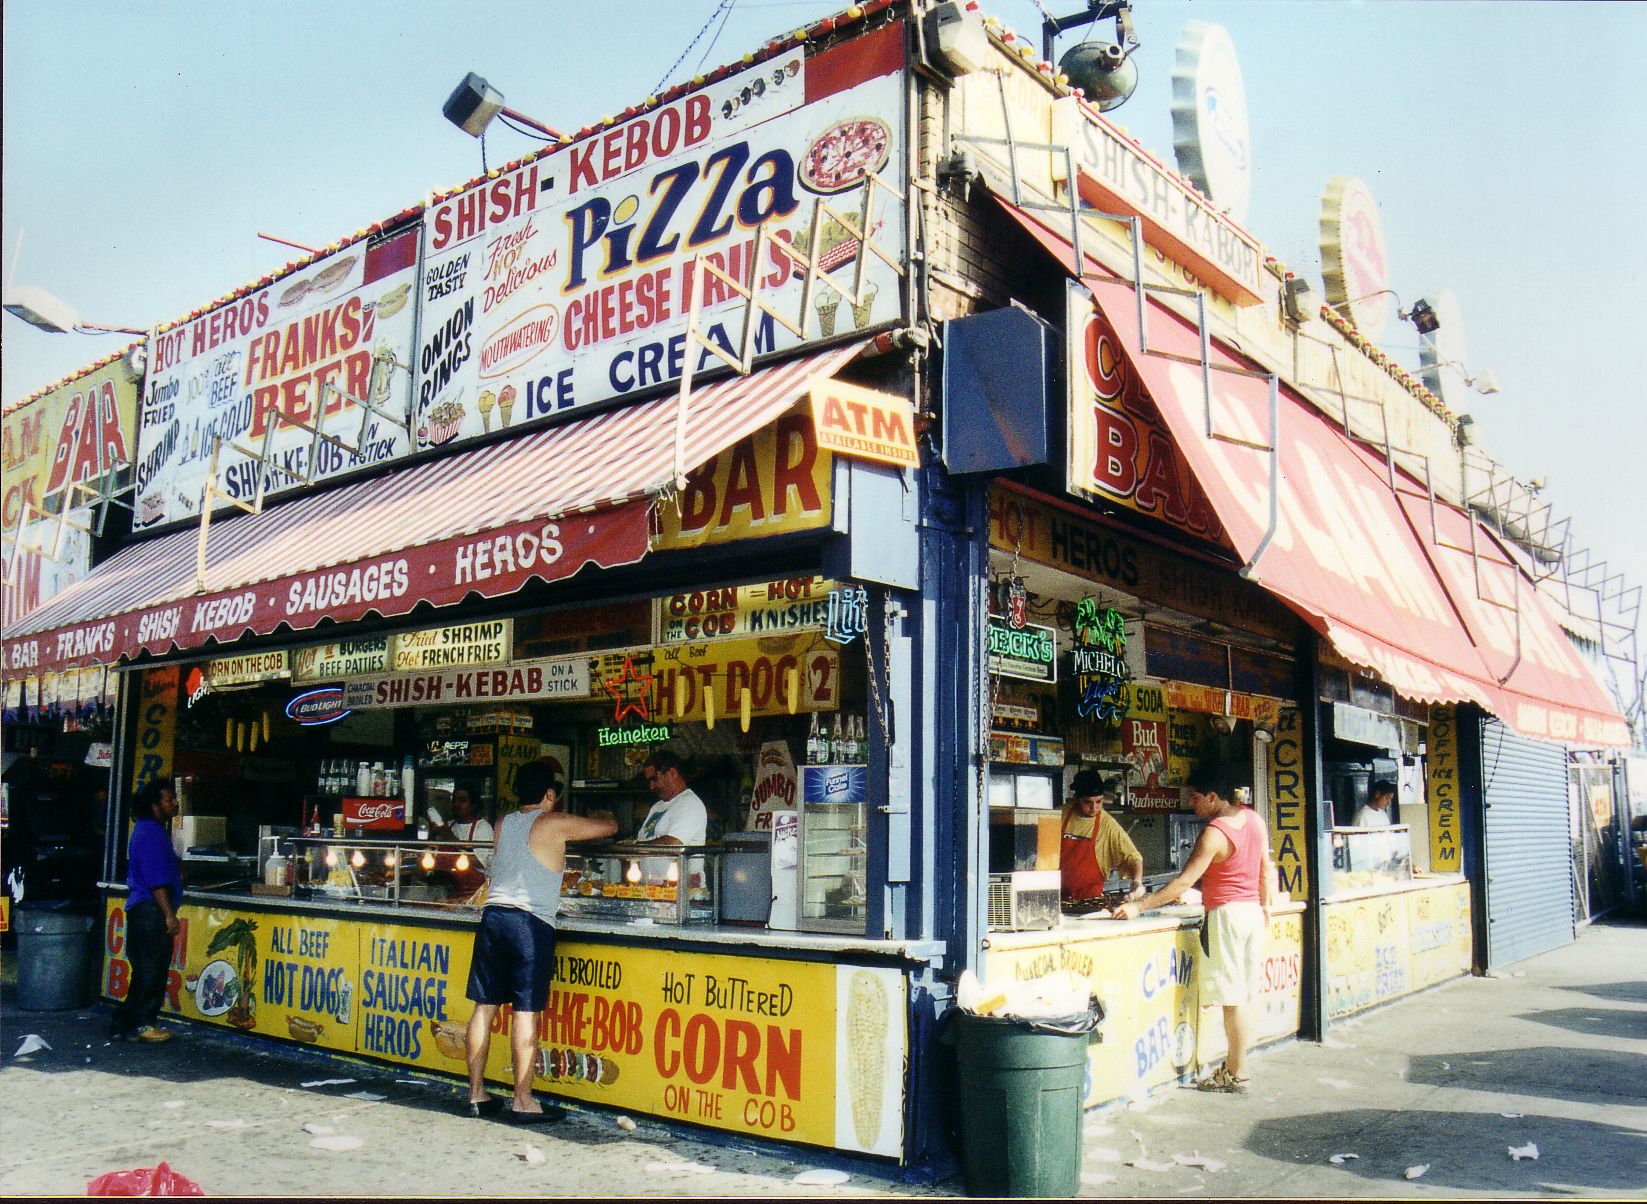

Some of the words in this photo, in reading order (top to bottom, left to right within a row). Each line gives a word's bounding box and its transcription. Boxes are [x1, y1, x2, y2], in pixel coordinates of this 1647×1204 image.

[484, 216, 539, 280] Fresh
[426, 252, 471, 285] GOLDEN
[428, 272, 466, 301] TASTY
[483, 249, 557, 313] Delicious
[563, 264, 671, 352] CHEESE
[153, 332, 185, 375] HOT
[191, 290, 269, 357] HEROS
[244, 296, 363, 386] FRANKS
[421, 296, 474, 374] ONION
[480, 315, 554, 372] MOUTHWATERING
[145, 376, 180, 407] Jumbo
[210, 372, 238, 405] BEEF
[418, 332, 472, 416] RINGS
[249, 350, 372, 438] BEER
[527, 368, 575, 418] ICE
[143, 402, 175, 428] FRIED
[200, 417, 218, 461] ICE
[219, 393, 253, 441] COLD
[821, 396, 910, 446] ATM
[46, 379, 128, 497] BAR
[820, 432, 881, 453] AVAILABLE
[882, 445, 916, 461] INSIDE
[137, 418, 180, 496] SHRIMP
[680, 412, 822, 532] BAR
[1051, 517, 1138, 587] HEROS
[669, 587, 738, 616] CORN
[767, 576, 815, 601] HOT
[56, 622, 116, 661] FRANKS
[137, 606, 183, 644] SHISH
[191, 591, 257, 632] KEBOB
[285, 559, 409, 615] SAUSAGES
[669, 618, 683, 630] ON
[684, 612, 736, 640] COB
[340, 640, 387, 656] BURGERS
[403, 630, 437, 648] Fried
[442, 622, 504, 644] SHRIMP
[666, 630, 681, 640] THE
[232, 659, 244, 675] ON
[245, 657, 262, 673] THE
[264, 653, 283, 671] COB
[320, 660, 341, 677] BEEF
[345, 655, 383, 674] PATTIES
[396, 650, 419, 668] Hot
[422, 645, 463, 667] FRENCH
[466, 641, 501, 662] FRIES
[551, 665, 564, 676] ON
[567, 664, 574, 675] A
[376, 667, 543, 705] SHISH-KEBAB
[548, 679, 578, 692] STICK
[1136, 688, 1164, 714] SODA
[300, 703, 318, 713] BUD
[318, 700, 341, 711] LIGHT
[443, 740, 469, 751] PEPSI
[599, 725, 669, 746] Heineken
[1132, 721, 1158, 748] Bud
[358, 803, 398, 818] Coca-Cola
[752, 773, 796, 811] JUMBO
[1127, 791, 1180, 810] Budweiser
[1273, 740, 1302, 893] CREAM
[1436, 783, 1455, 860] CREAM
[271, 926, 293, 954] ALL
[299, 928, 330, 959] BEEF
[369, 937, 449, 974] ITALIAN
[264, 959, 298, 1007] HOT
[300, 964, 345, 1016] DOGS
[568, 957, 622, 989] BROILED
[662, 972, 695, 1005] HOT
[1142, 944, 1194, 998] CLAM
[361, 969, 448, 1022] SAUSAGE
[363, 1012, 423, 1060] HEROS
[653, 1008, 802, 1101] CORN
[1135, 1016, 1171, 1079] BAR
[664, 1084, 690, 1114] ON
[696, 1089, 723, 1120] THE
[744, 1098, 796, 1132] COB
